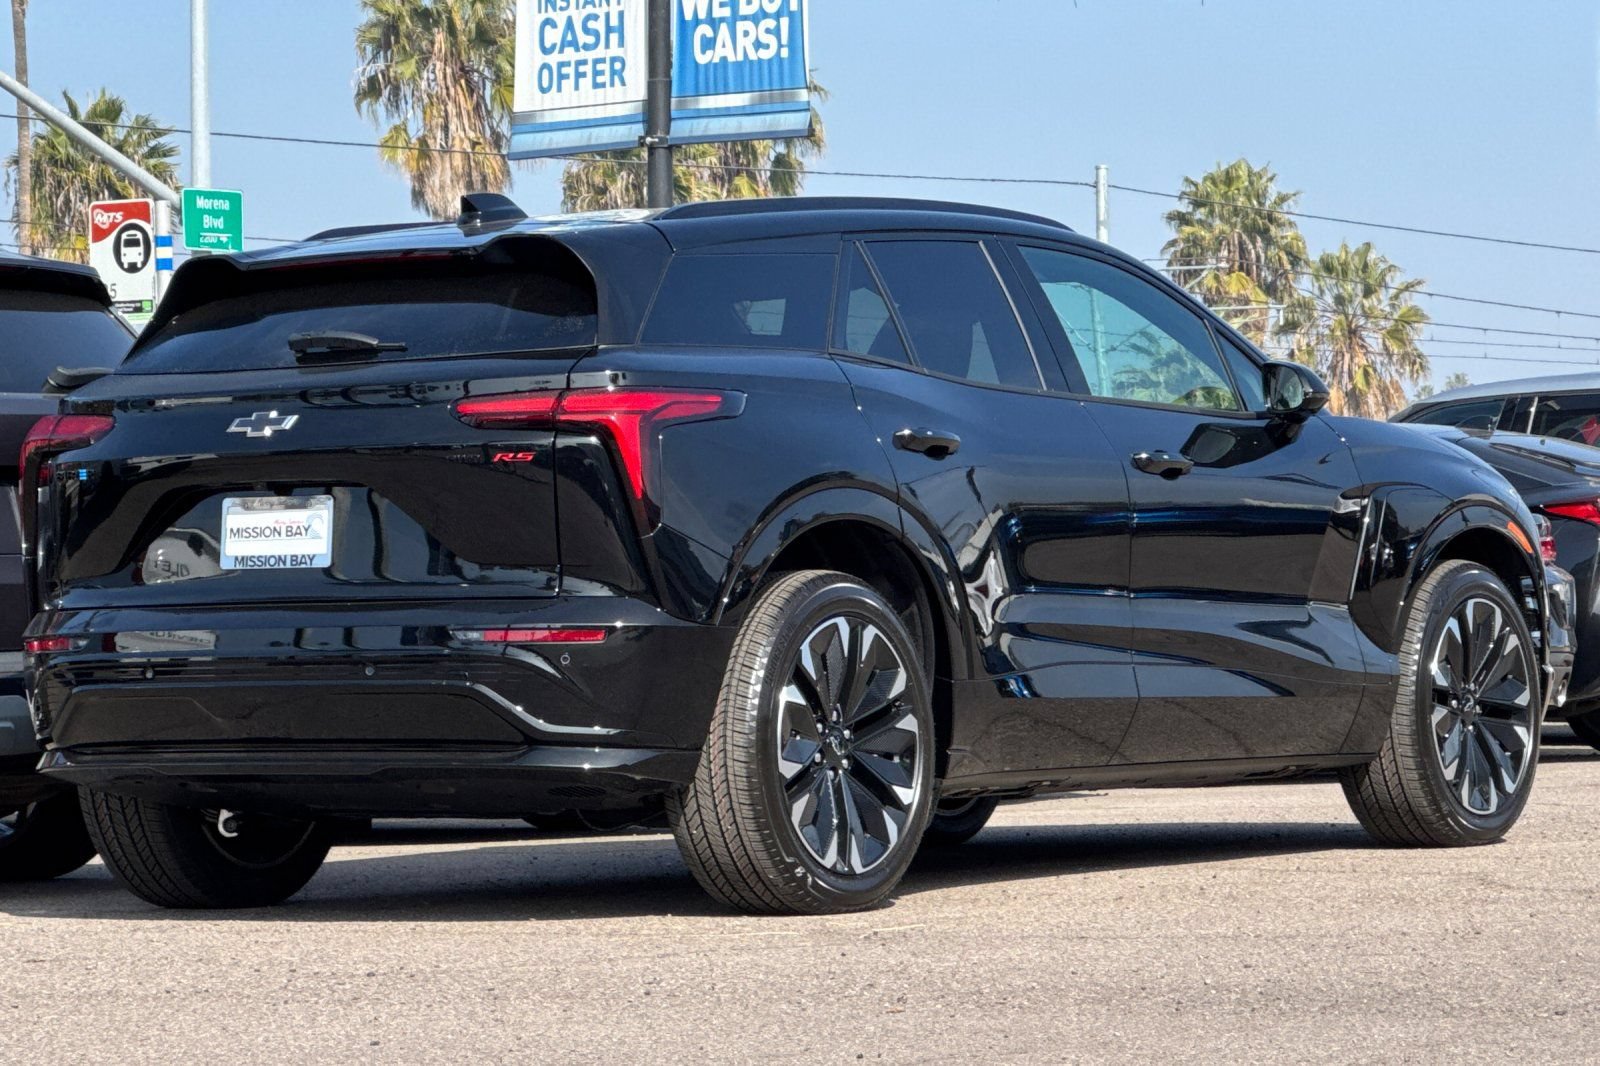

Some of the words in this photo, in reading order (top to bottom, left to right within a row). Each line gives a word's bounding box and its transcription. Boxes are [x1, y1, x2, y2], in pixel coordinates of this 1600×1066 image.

[539, 11, 625, 56] CASH
[693, 17, 789, 64] CARS!
[537, 56, 627, 94] OFFER
[196, 195, 230, 211] Morena
[203, 214, 224, 229] Blvd
[493, 452, 537, 462] RS
[229, 526, 282, 540] MISSION
[285, 525, 311, 538] BAY
[233, 555, 287, 568] MISSION
[290, 554, 316, 567] BAY
